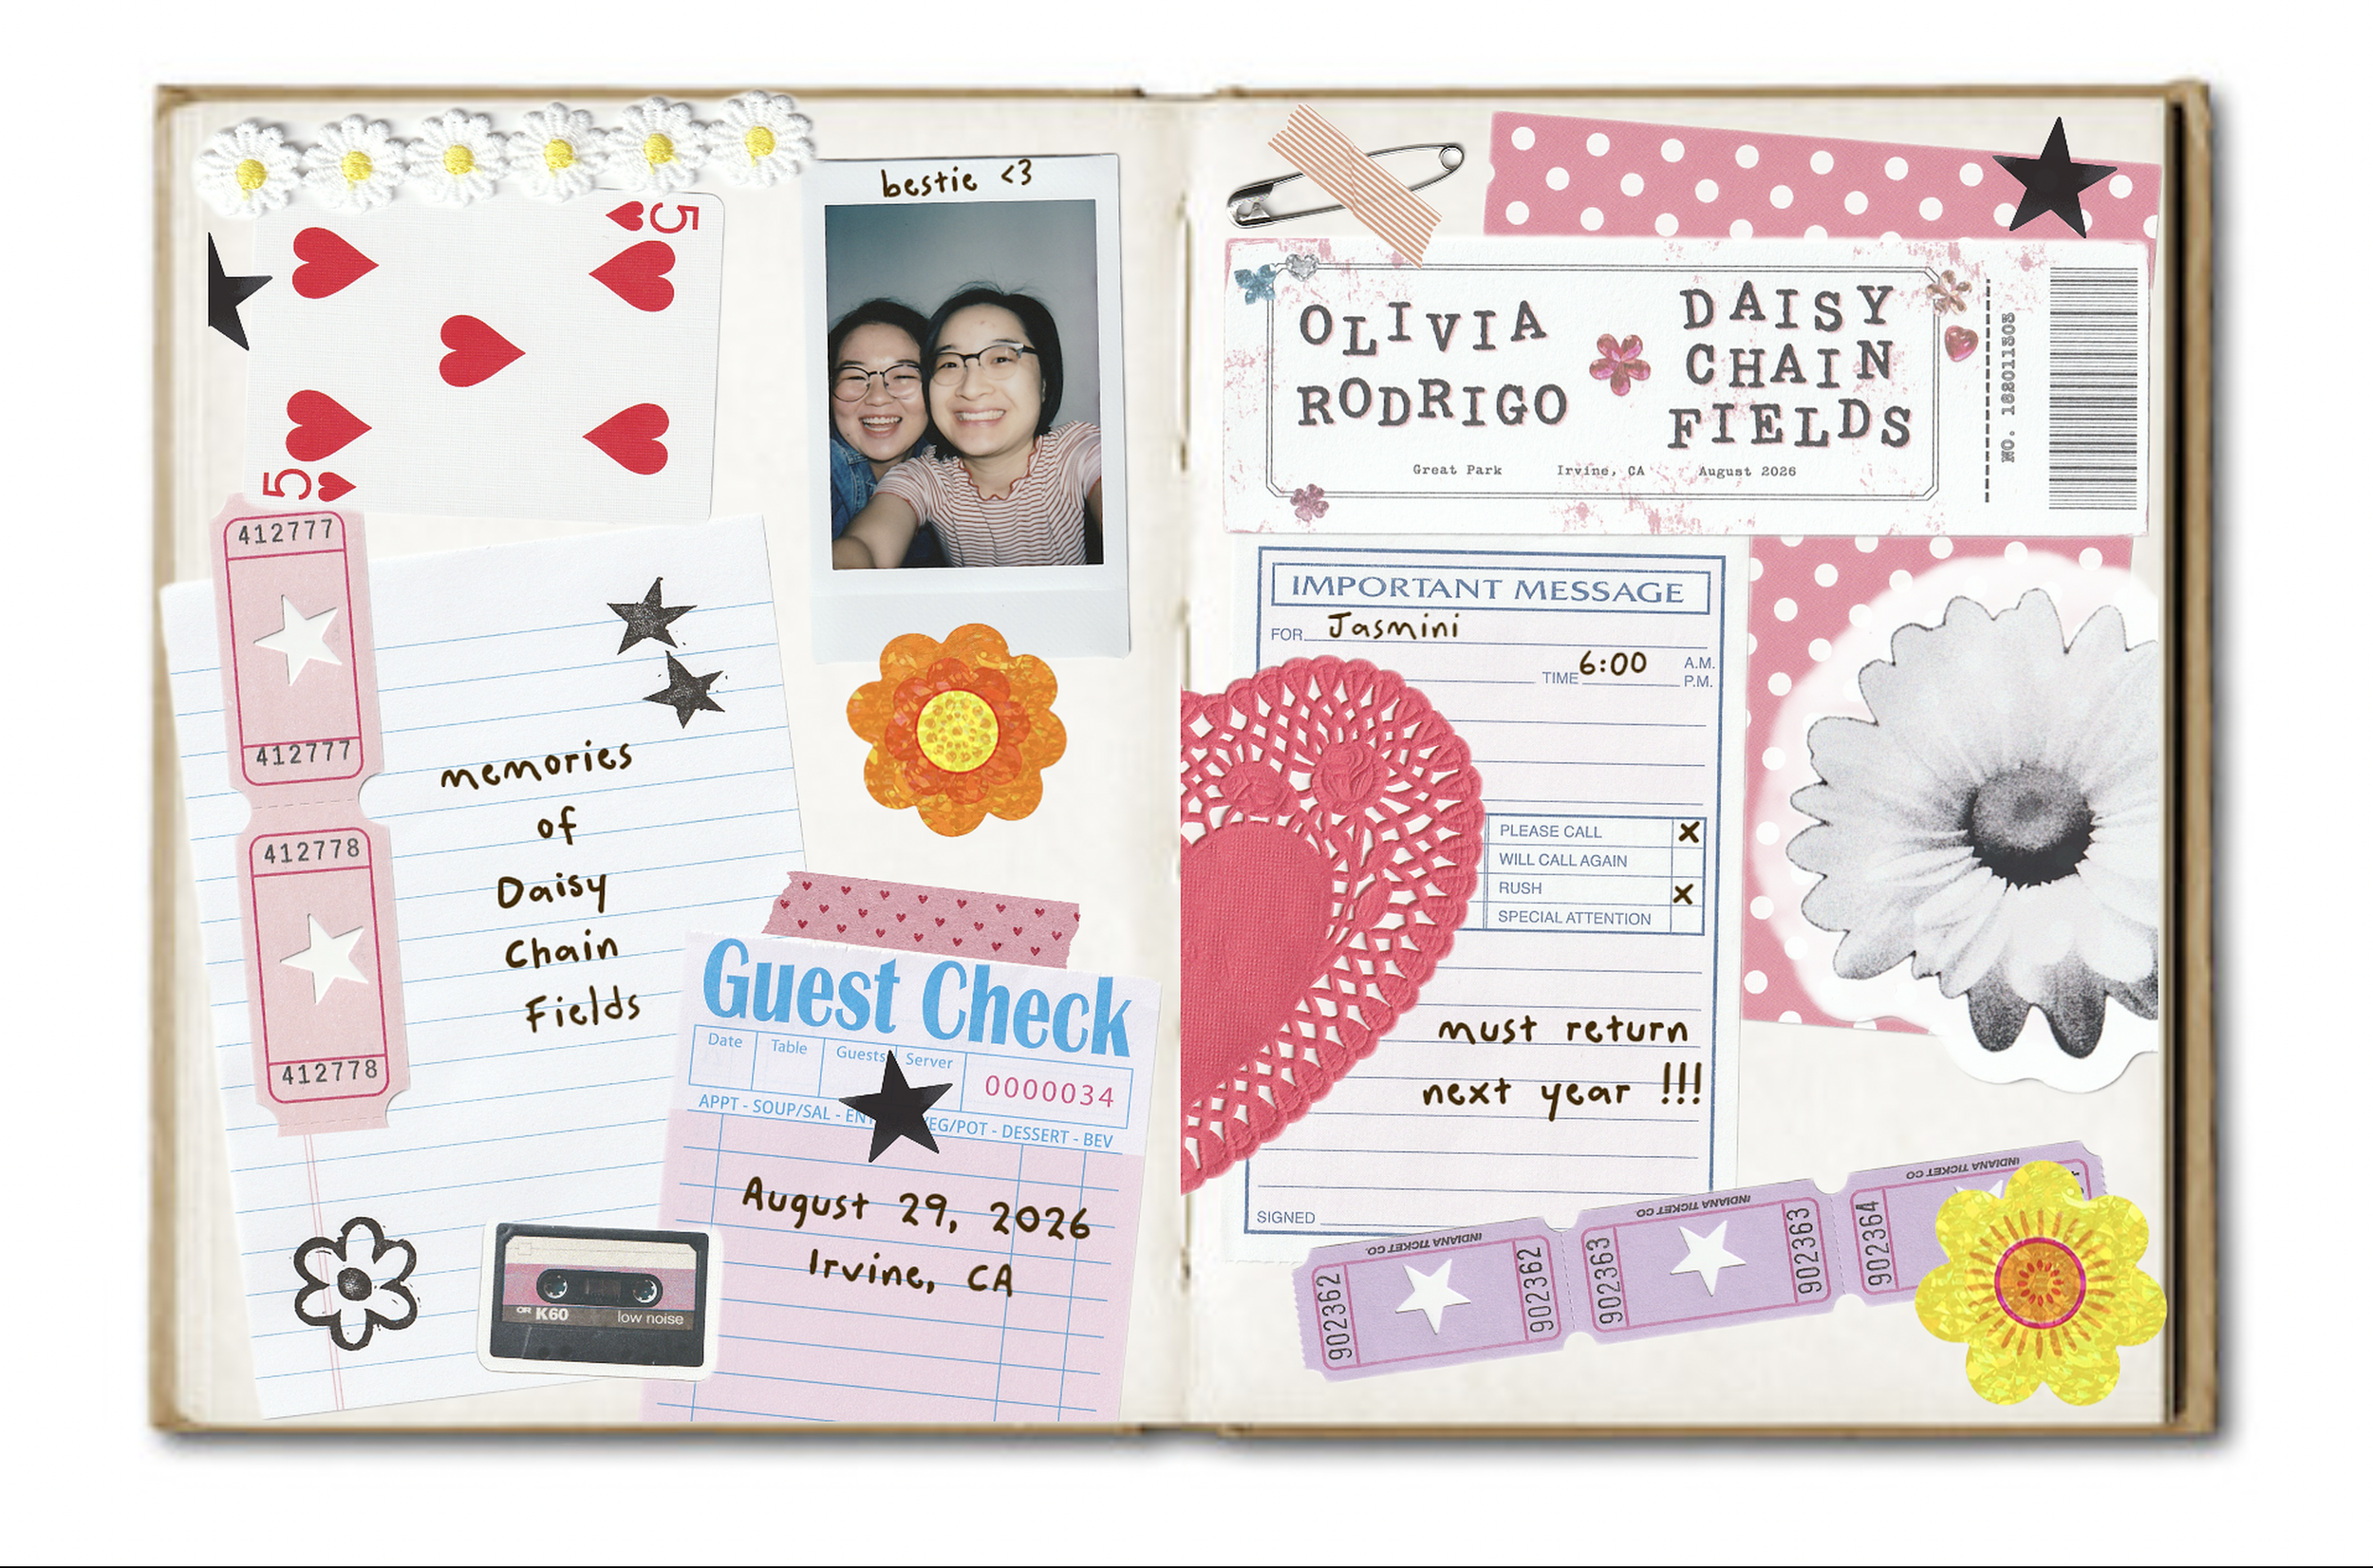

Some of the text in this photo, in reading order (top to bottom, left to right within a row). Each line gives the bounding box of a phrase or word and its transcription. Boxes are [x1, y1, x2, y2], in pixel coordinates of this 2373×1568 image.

[881, 166, 978, 197] bestie
[649, 202, 700, 234] 5
[1679, 280, 1894, 333] DAISY
[1299, 300, 1547, 356] OLIVIA
[1686, 340, 1894, 389] CHAIN
[1297, 377, 1567, 427] RODRIGO
[1667, 398, 1911, 449] FIELDS
[2000, 430, 2015, 463] NO.
[262, 468, 312, 500] 5
[1412, 464, 1503, 476] Great Park
[1558, 465, 1645, 477] Irvine, CA
[1698, 465, 1797, 479] August 2026
[237, 518, 334, 545] 412777
[1291, 574, 1684, 604] IMPORTANT MESSAGE
[1271, 627, 1303, 642] FOR
[1328, 611, 1459, 640] Jasmini
[1579, 650, 1647, 676] 6:00
[1684, 656, 1715, 669] A.M.
[1542, 671, 1579, 685] TIME
[1684, 675, 1713, 688] P.M.
[255, 739, 352, 767] 412777
[440, 739, 632, 790] memories
[537, 805, 577, 846] of
[1500, 823, 1602, 839] PLEASE CALL
[264, 838, 360, 864] 412778
[1499, 852, 1628, 868] WILL CALL AGAIN
[497, 872, 607, 914] Daisy
[1499, 881, 1542, 895] RUSH
[1498, 909, 1652, 926] SPECIAL ATTENTION
[505, 928, 618, 969] Chain
[525, 985, 640, 1033] Fields
[702, 937, 1132, 1058] Guest Check
[707, 1032, 743, 1049] Date
[1438, 1015, 1688, 1045] must return
[771, 1038, 808, 1055] Table
[835, 1045, 887, 1063] Guests
[281, 1059, 379, 1086] 412778
[905, 1052, 954, 1070] Server
[985, 1074, 1114, 1108] 0000034
[1423, 1061, 1702, 1122] next year !!!
[698, 1093, 739, 1111] APPT
[752, 1098, 831, 1121] SOUP/SAL
[1001, 1124, 1070, 1145] DESSERT
[1083, 1132, 1113, 1148] BEV
[1926, 1164, 1970, 1177] TICKET
[1971, 1157, 2020, 1170] INDIANA
[742, 1176, 1091, 1241] August 29, 2026
[1655, 1202, 1700, 1216] TICKET
[1701, 1194, 1751, 1208] INDIANA
[1257, 1209, 1316, 1224] SIGNED
[1387, 1239, 1431, 1254] TICKET
[1431, 1232, 1483, 1247] INDIANA
[1785, 1207, 1822, 1295] 902363
[1855, 1201, 1892, 1286] 902364
[810, 1248, 1013, 1297] Irvine, CA
[1585, 1238, 1623, 1324] 902363
[1516, 1246, 1554, 1333] 902362
[535, 1306, 570, 1321] K60
[617, 1310, 643, 1323] low
[645, 1315, 684, 1326] noise
[1316, 1273, 1353, 1360] 902362
